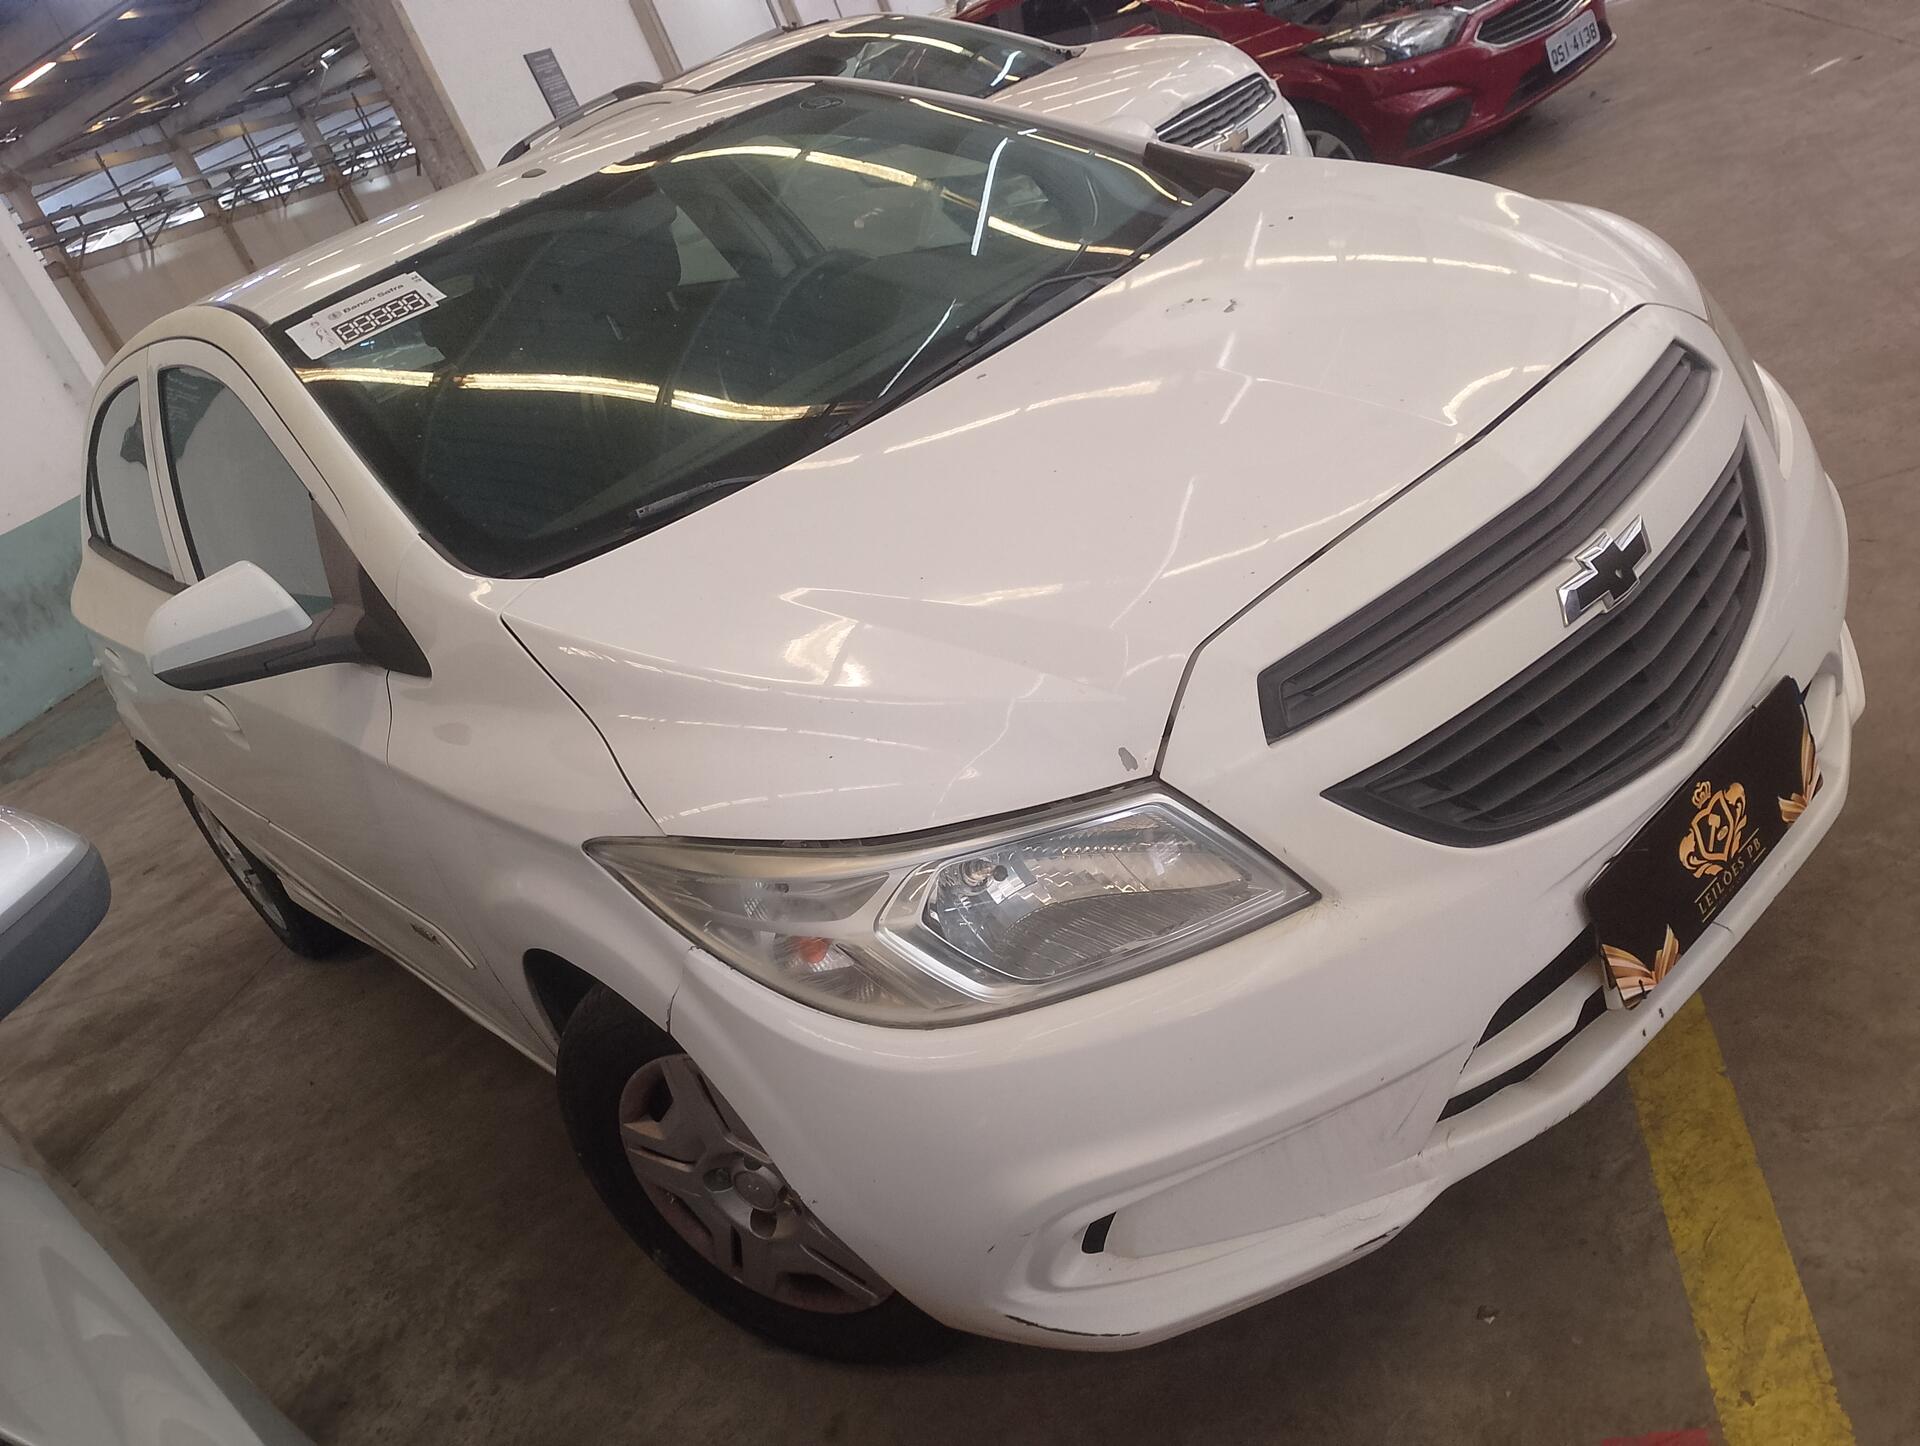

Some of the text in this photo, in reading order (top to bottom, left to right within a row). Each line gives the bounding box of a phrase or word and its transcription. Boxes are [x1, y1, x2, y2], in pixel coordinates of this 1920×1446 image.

[343, 283, 404, 314] Banco Safra
[1747, 837, 1762, 859] PB
